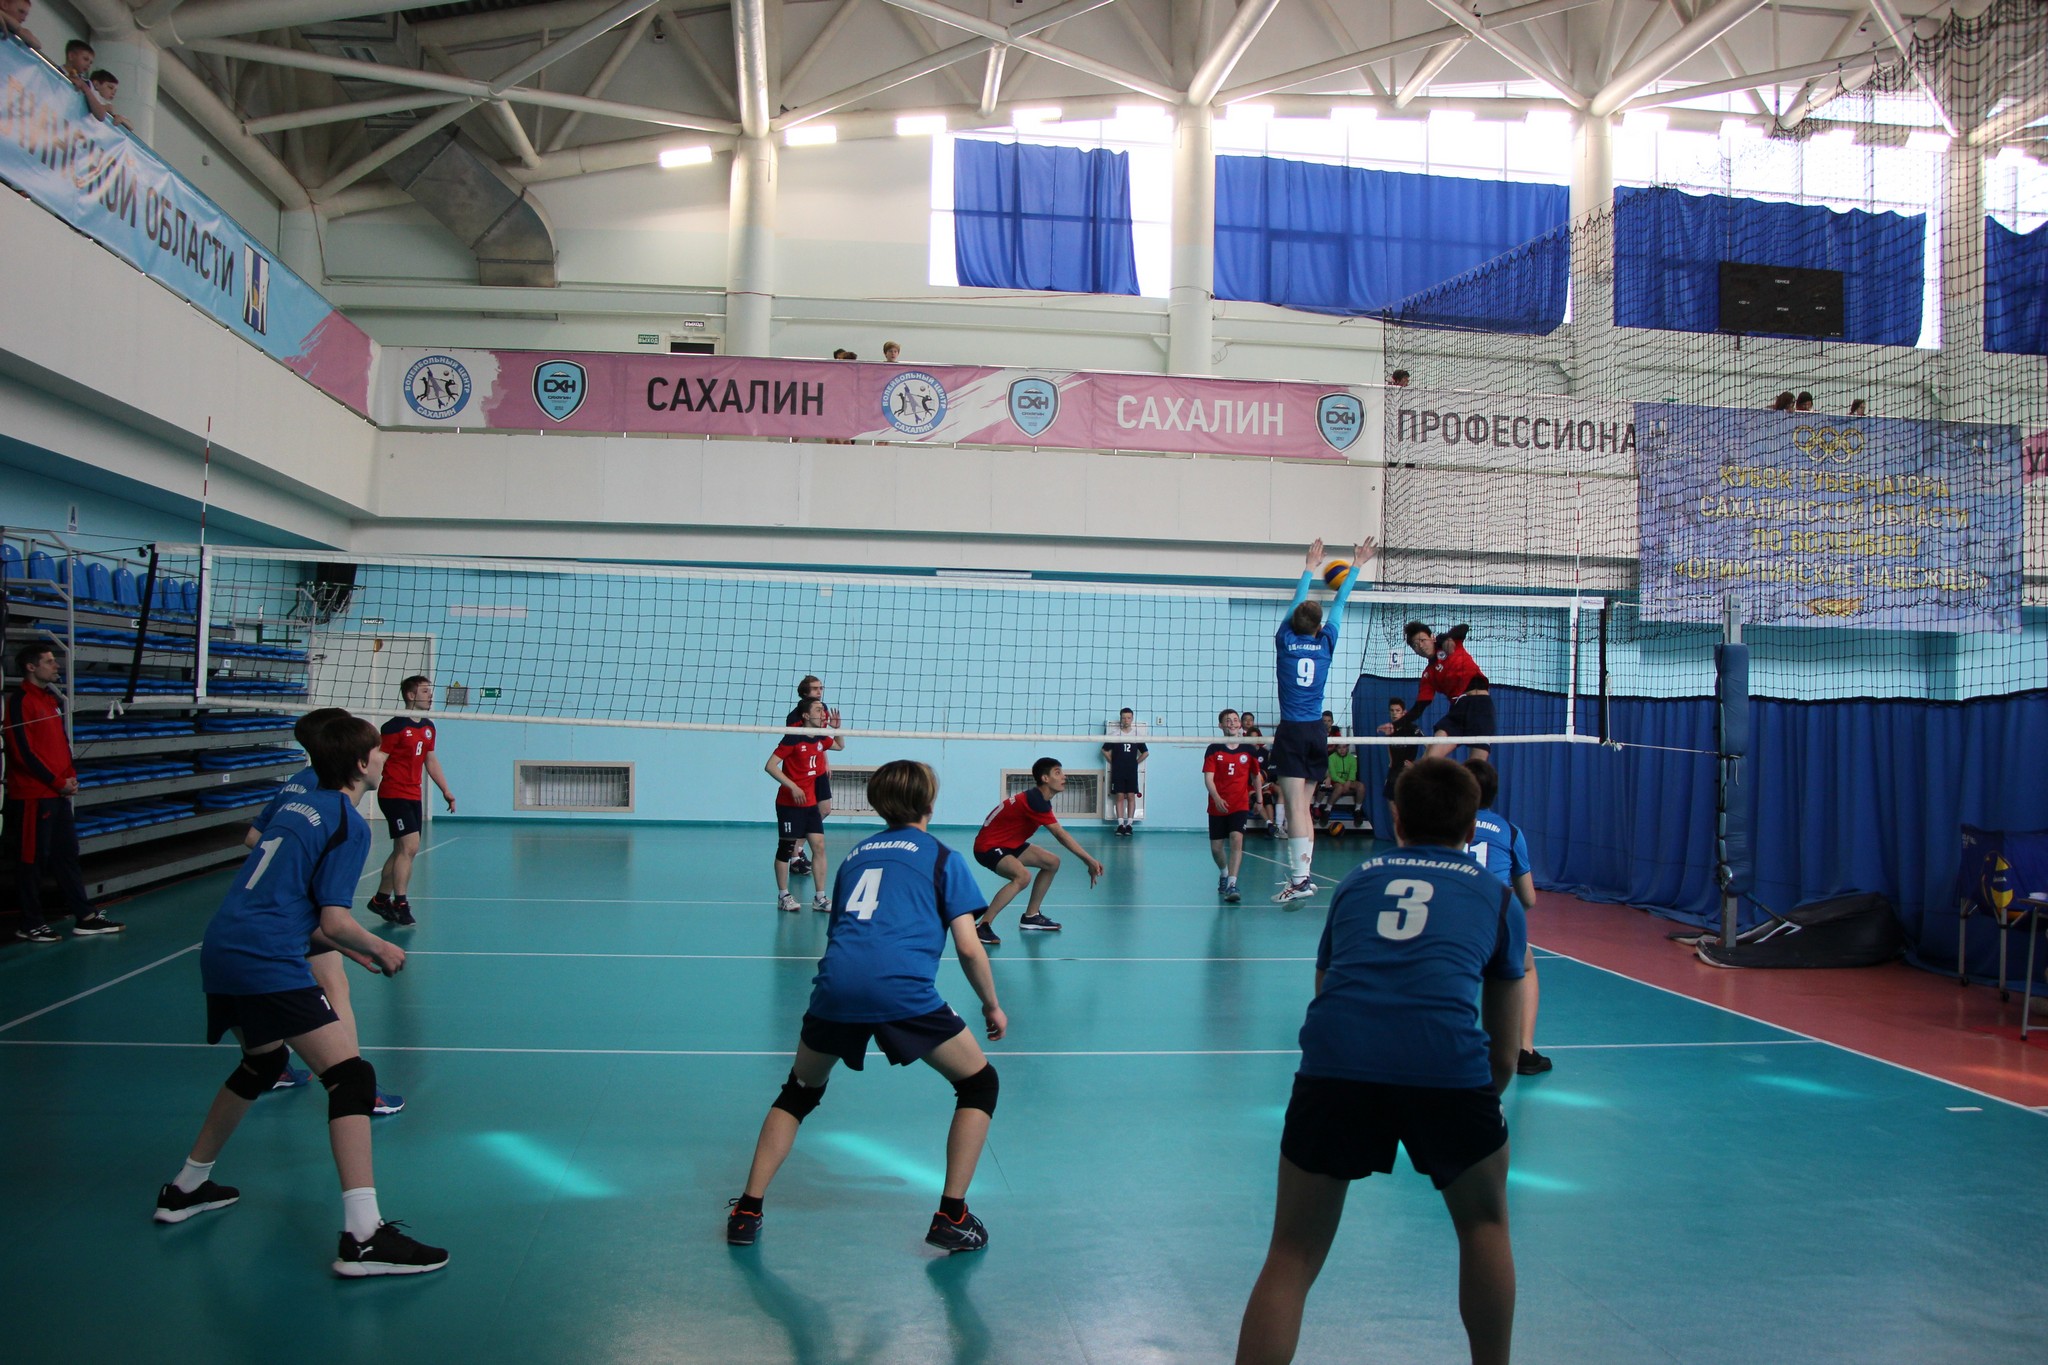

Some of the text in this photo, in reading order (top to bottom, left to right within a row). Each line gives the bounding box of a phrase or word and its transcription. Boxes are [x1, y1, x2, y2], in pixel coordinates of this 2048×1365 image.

[146, 186, 235, 297] ОБЛАСТИ
[405, 357, 471, 393] ВОЛЕЙБОЛЬНЫЙ ЦЕНТР
[882, 373, 935, 407] ВОЛЕЙБОЛЬНЫЙ
[417, 407, 456, 418] САХАЛИН
[647, 377, 825, 416] САХАЛИН
[894, 421, 933, 433] САХАЛИН
[1116, 394, 1284, 436] САХАЛИН
[1719, 464, 1950, 498] КУБОК ГУБЕРНАТОРА
[1700, 495, 1970, 529] САХАЛИНСКОЙ ОБЛАСТИ
[1752, 529, 1922, 557] ПО ВОЛЕЙБОЛУ
[1296, 658, 1315, 687] 9
[1123, 743, 1131, 752] 12
[1228, 763, 1235, 775] 5
[245, 836, 284, 890] 1
[1387, 857, 1479, 876] «САХАЛИН»
[846, 868, 884, 920] 4
[1376, 878, 1435, 941] 3
